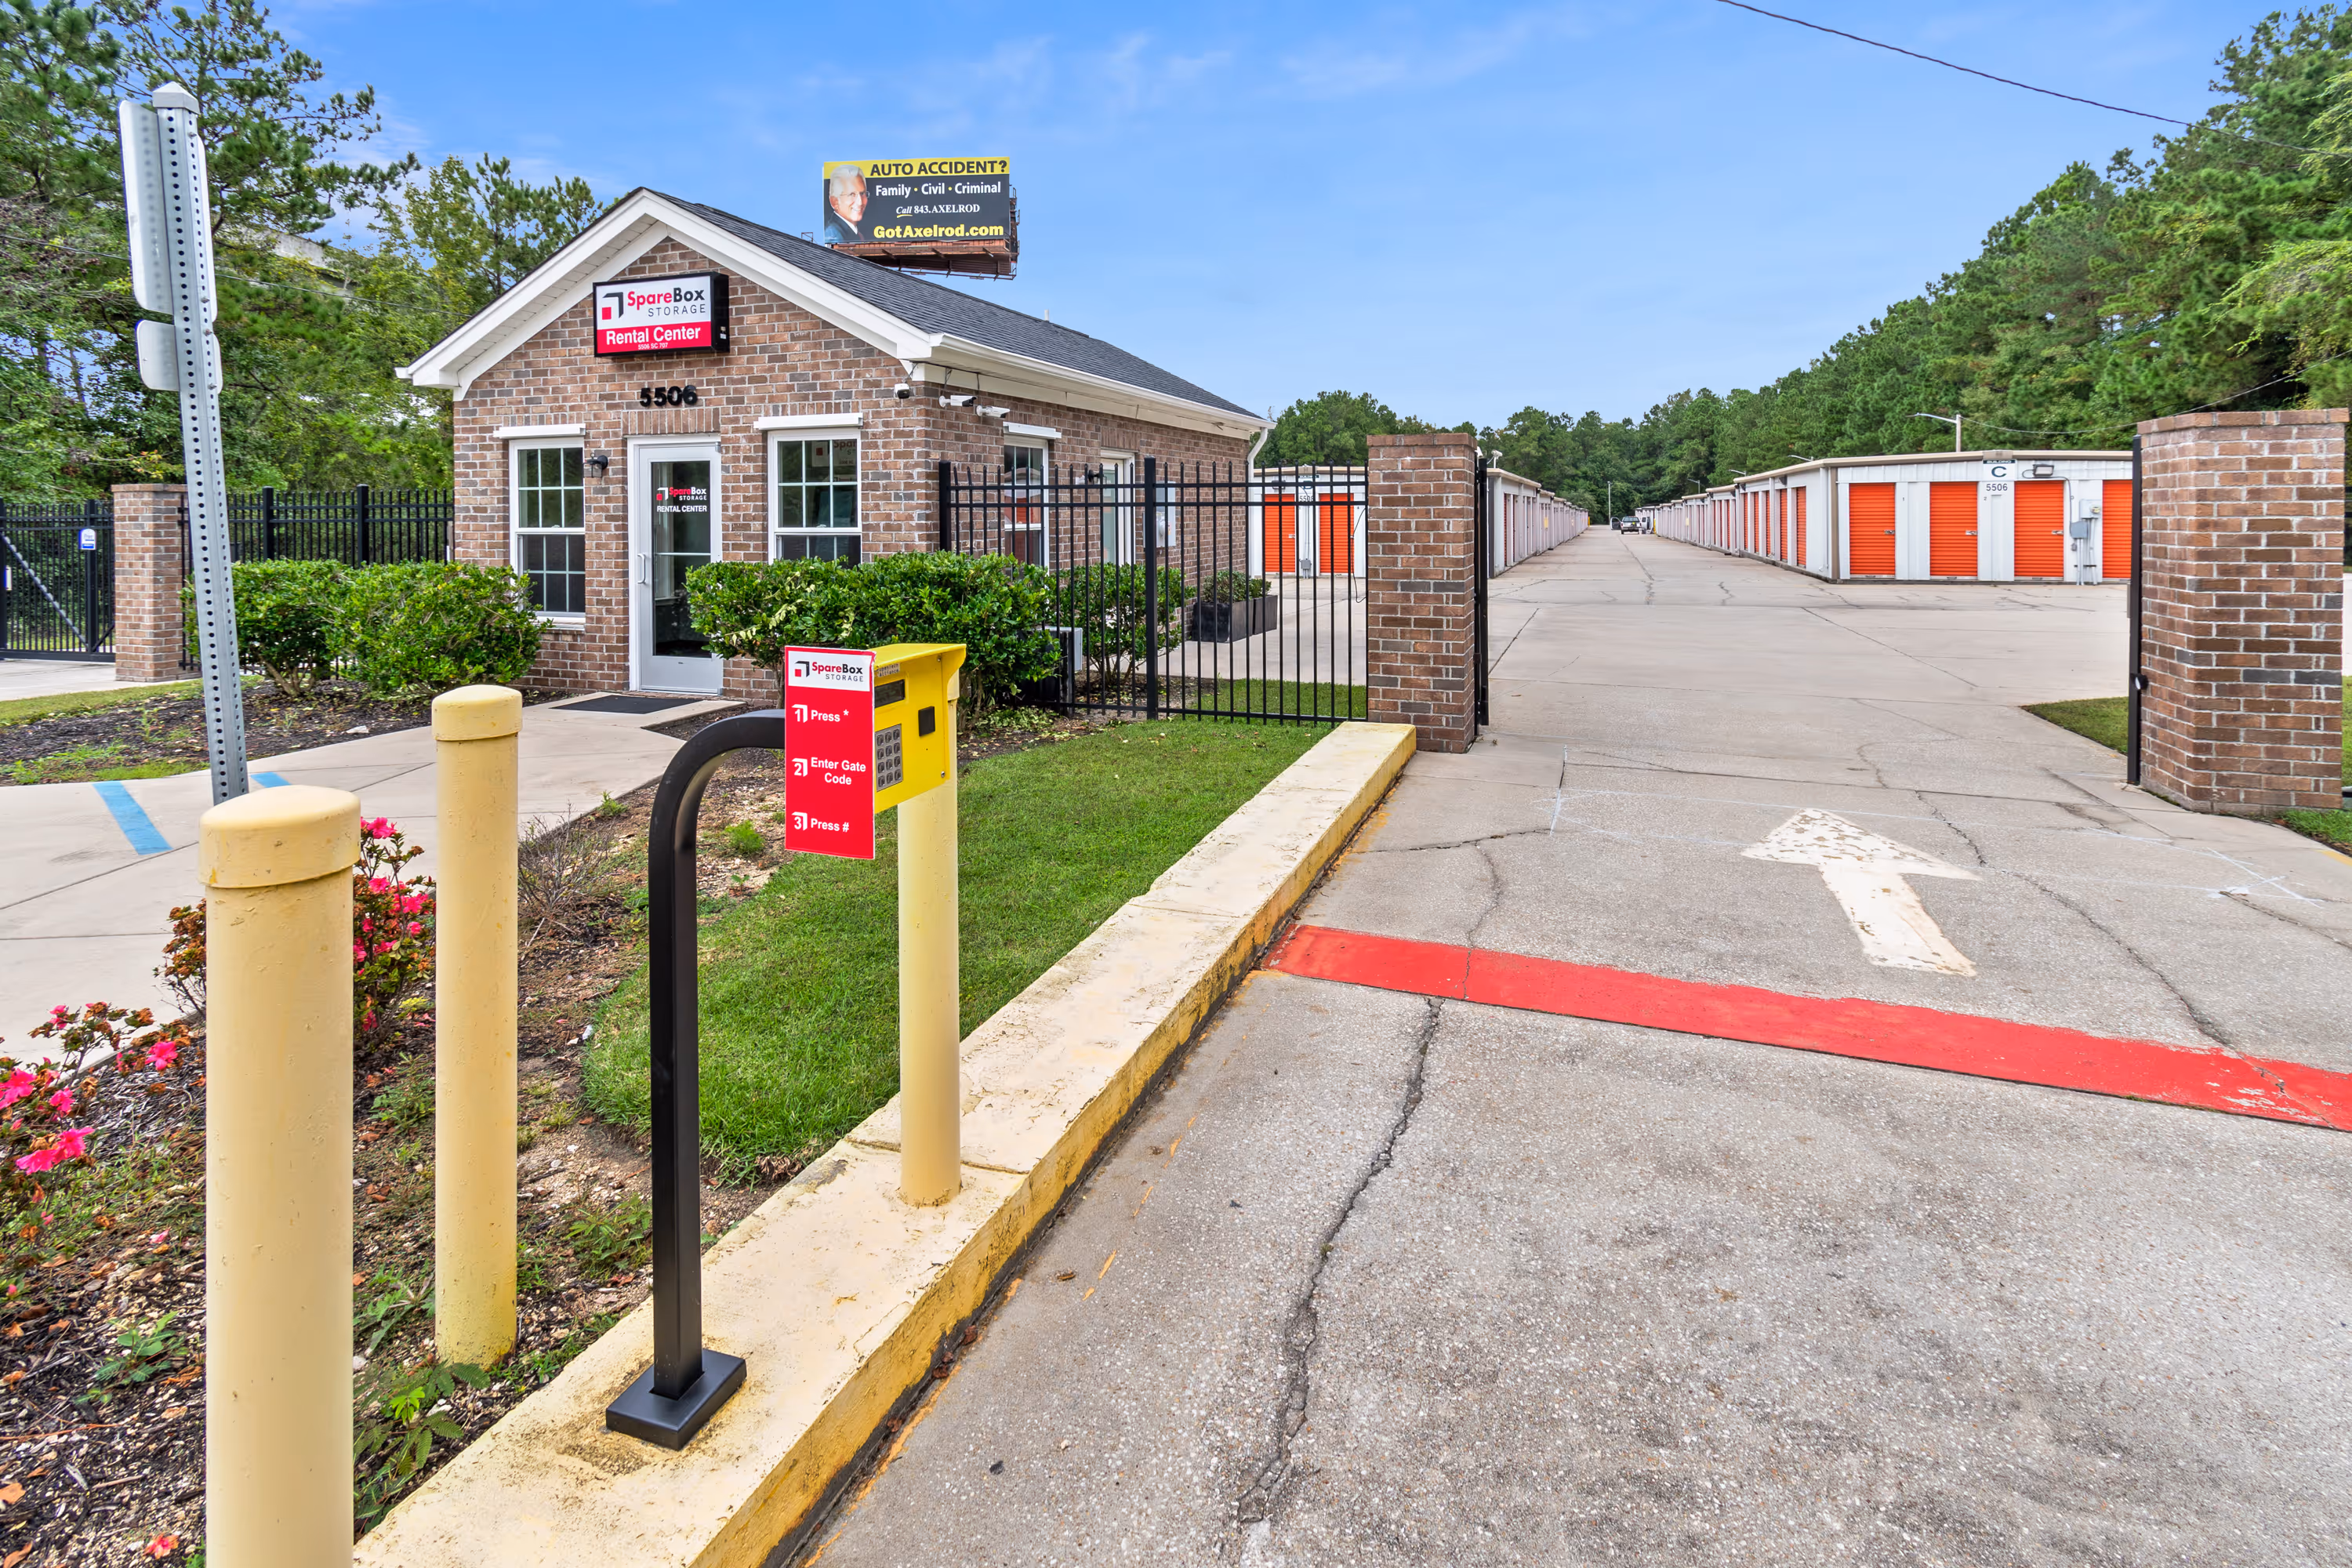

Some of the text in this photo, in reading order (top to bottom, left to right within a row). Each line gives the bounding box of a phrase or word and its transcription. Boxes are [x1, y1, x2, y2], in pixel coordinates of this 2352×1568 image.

[870, 160, 1007, 176] AUTO ACCIDENT?
[876, 181, 1001, 198] Family Civil Criminal
[895, 204, 980, 215] Call 843.AXELROD
[873, 224, 1004, 238] GotAxelrod.com
[627, 287, 705, 310] SpareBox
[648, 303, 706, 317] STORAGE
[606, 325, 701, 345] Rental Center
[639, 384, 698, 407] 5506
[1991, 466, 2007, 477] C
[669, 486, 707, 498] SpareBox
[1986, 483, 2008, 492] 5506
[811, 662, 863, 674] SpareBox
[826, 673, 863, 682] STORAGE
[795, 710, 801, 722] 1
[811, 710, 840, 722] Press
[794, 757, 866, 776] 2 Enter Gate
[824, 772, 852, 785] Code
[794, 816, 850, 833] 3 Press #
